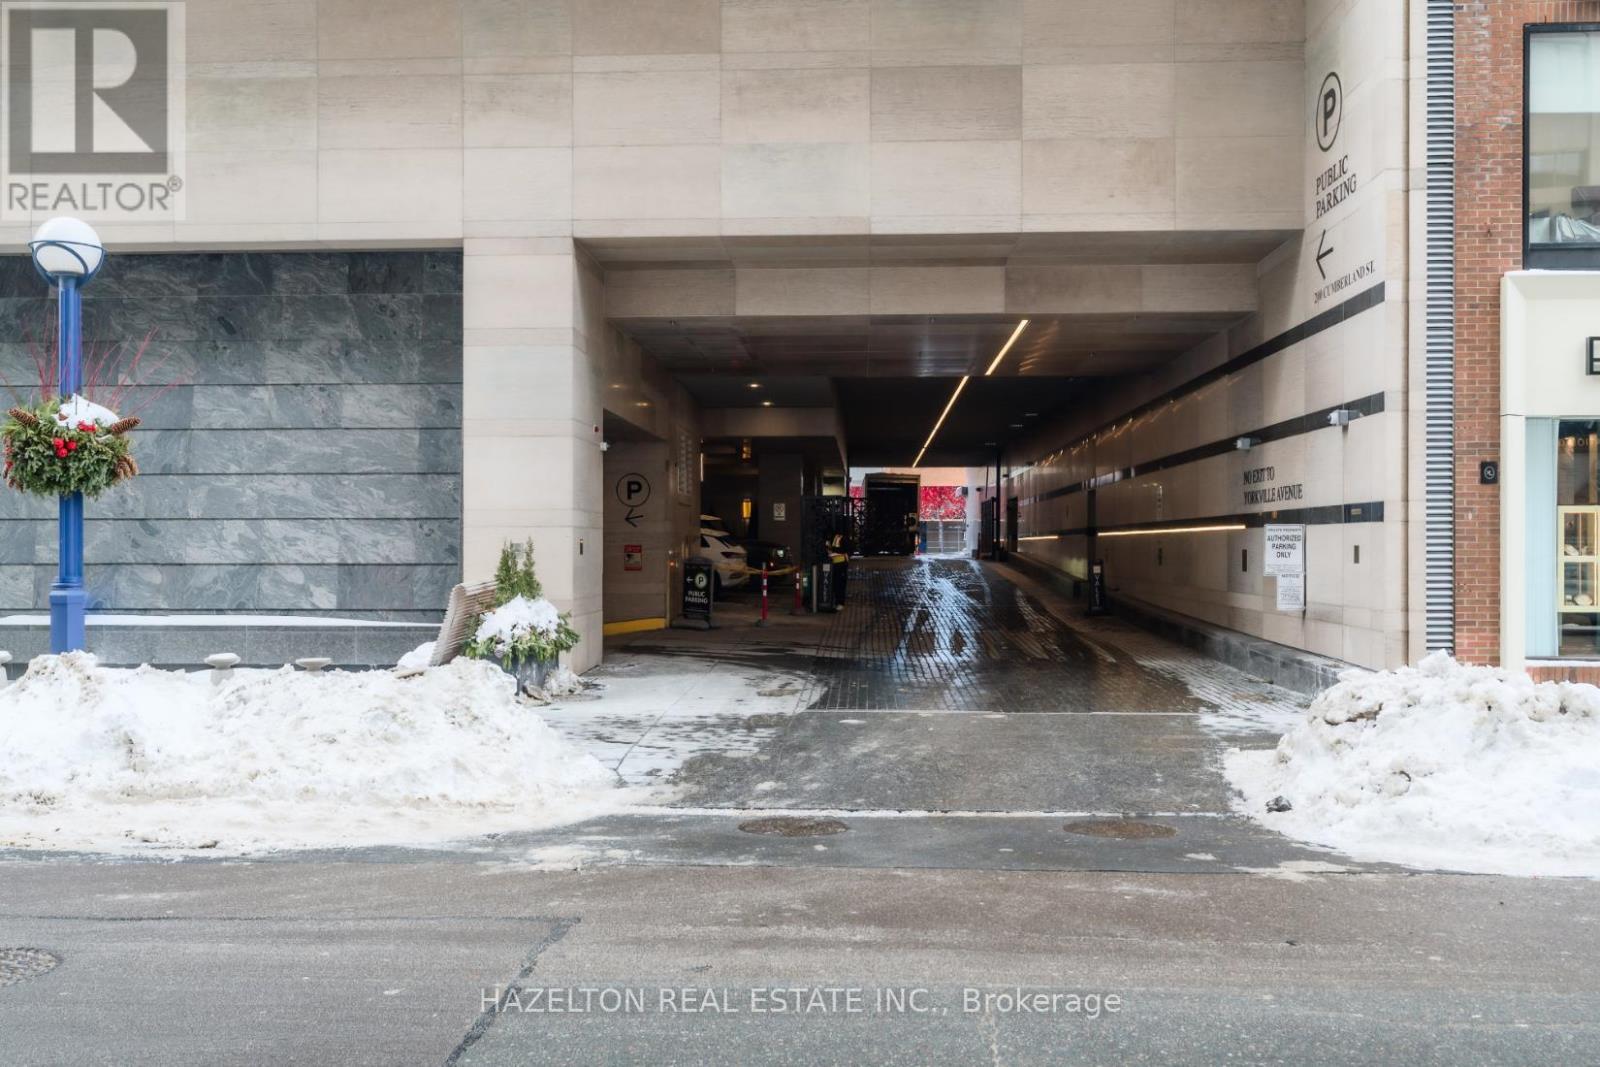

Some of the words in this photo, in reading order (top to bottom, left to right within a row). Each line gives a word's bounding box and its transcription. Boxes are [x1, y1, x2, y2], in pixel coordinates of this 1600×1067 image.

[1323, 87, 1336, 137] P
[1316, 154, 1349, 196] PUBLIC
[1316, 173, 1357, 219] PARKING
[1322, 266, 1366, 299] CUMBERLAND
[1243, 470, 1252, 485] NO
[1252, 467, 1266, 483] EXIT
[1266, 466, 1275, 481] TO
[627, 481, 642, 499] P
[1243, 487, 1276, 505] YORKVILLE
[1276, 484, 1303, 501] AVENUE
[1267, 534, 1302, 542] AUTHORIZED
[1276, 551, 1292, 559] ONLY
[684, 596, 708, 605] PARKING
[687, 590, 706, 598] PUBLIC
